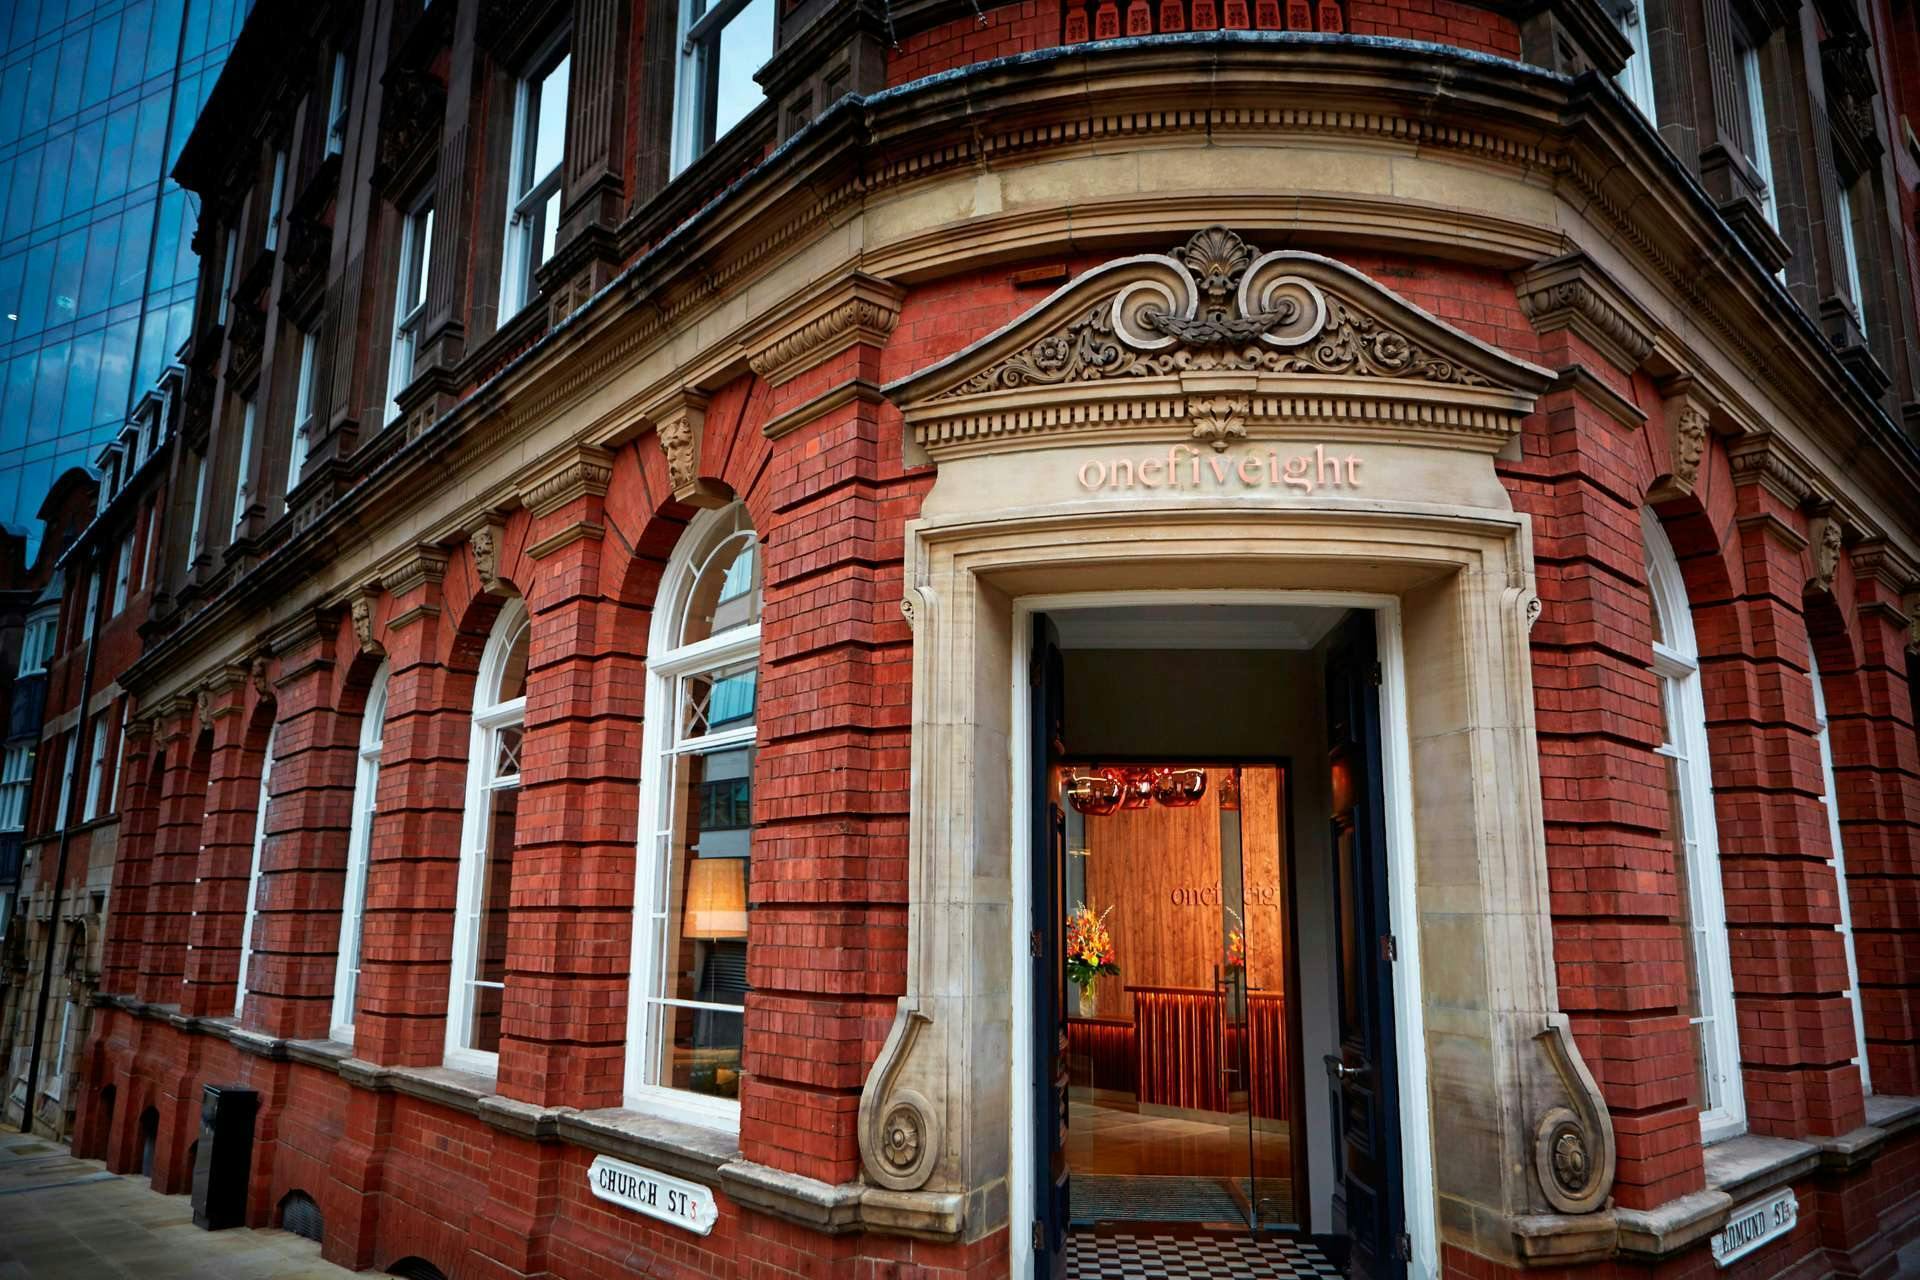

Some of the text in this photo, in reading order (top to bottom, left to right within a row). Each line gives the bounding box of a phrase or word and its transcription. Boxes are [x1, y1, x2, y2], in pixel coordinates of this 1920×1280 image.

[1078, 444, 1364, 493] onefiveight
[599, 1168, 658, 1206] CHURCH
[1722, 1211, 1766, 1253] EDMUND
